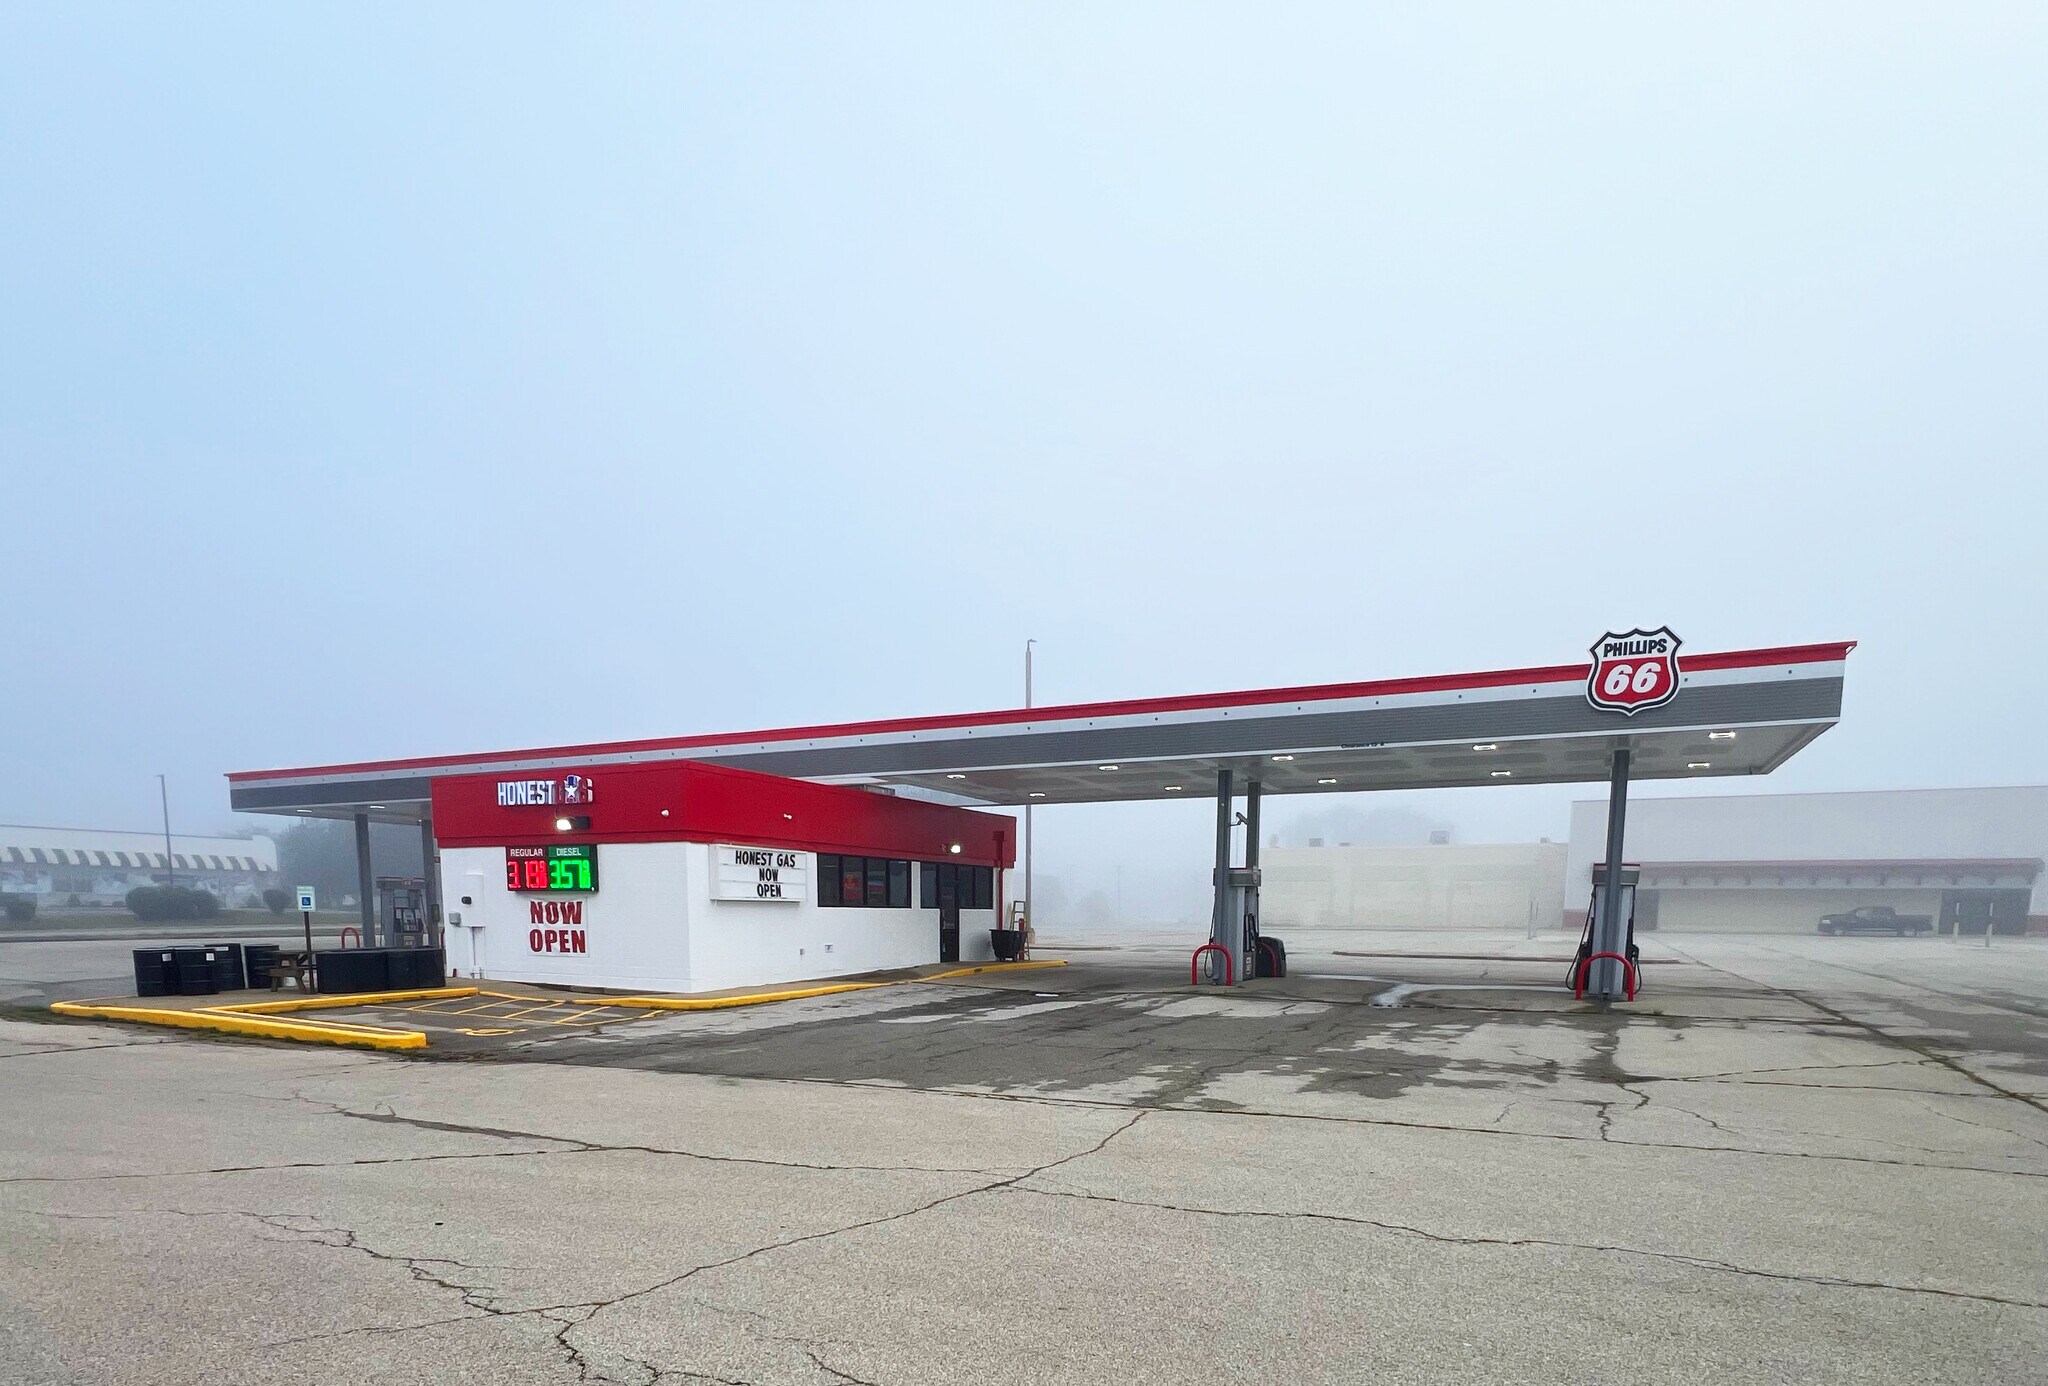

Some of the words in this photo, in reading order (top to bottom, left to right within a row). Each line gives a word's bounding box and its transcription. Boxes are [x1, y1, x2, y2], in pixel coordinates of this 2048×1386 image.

[1603, 638, 1667, 657] PHILLIPS
[1604, 663, 1661, 695] 66
[497, 780, 557, 805] HONEST
[510, 848, 543, 857] REGULAR
[556, 847, 581, 856] DIESEL
[735, 850, 773, 866] HONEST
[777, 854, 796, 867] GAS
[759, 868, 779, 881] NOW
[757, 884, 781, 897] OPEN
[530, 901, 583, 924] NOW
[530, 929, 586, 953] OPEN
